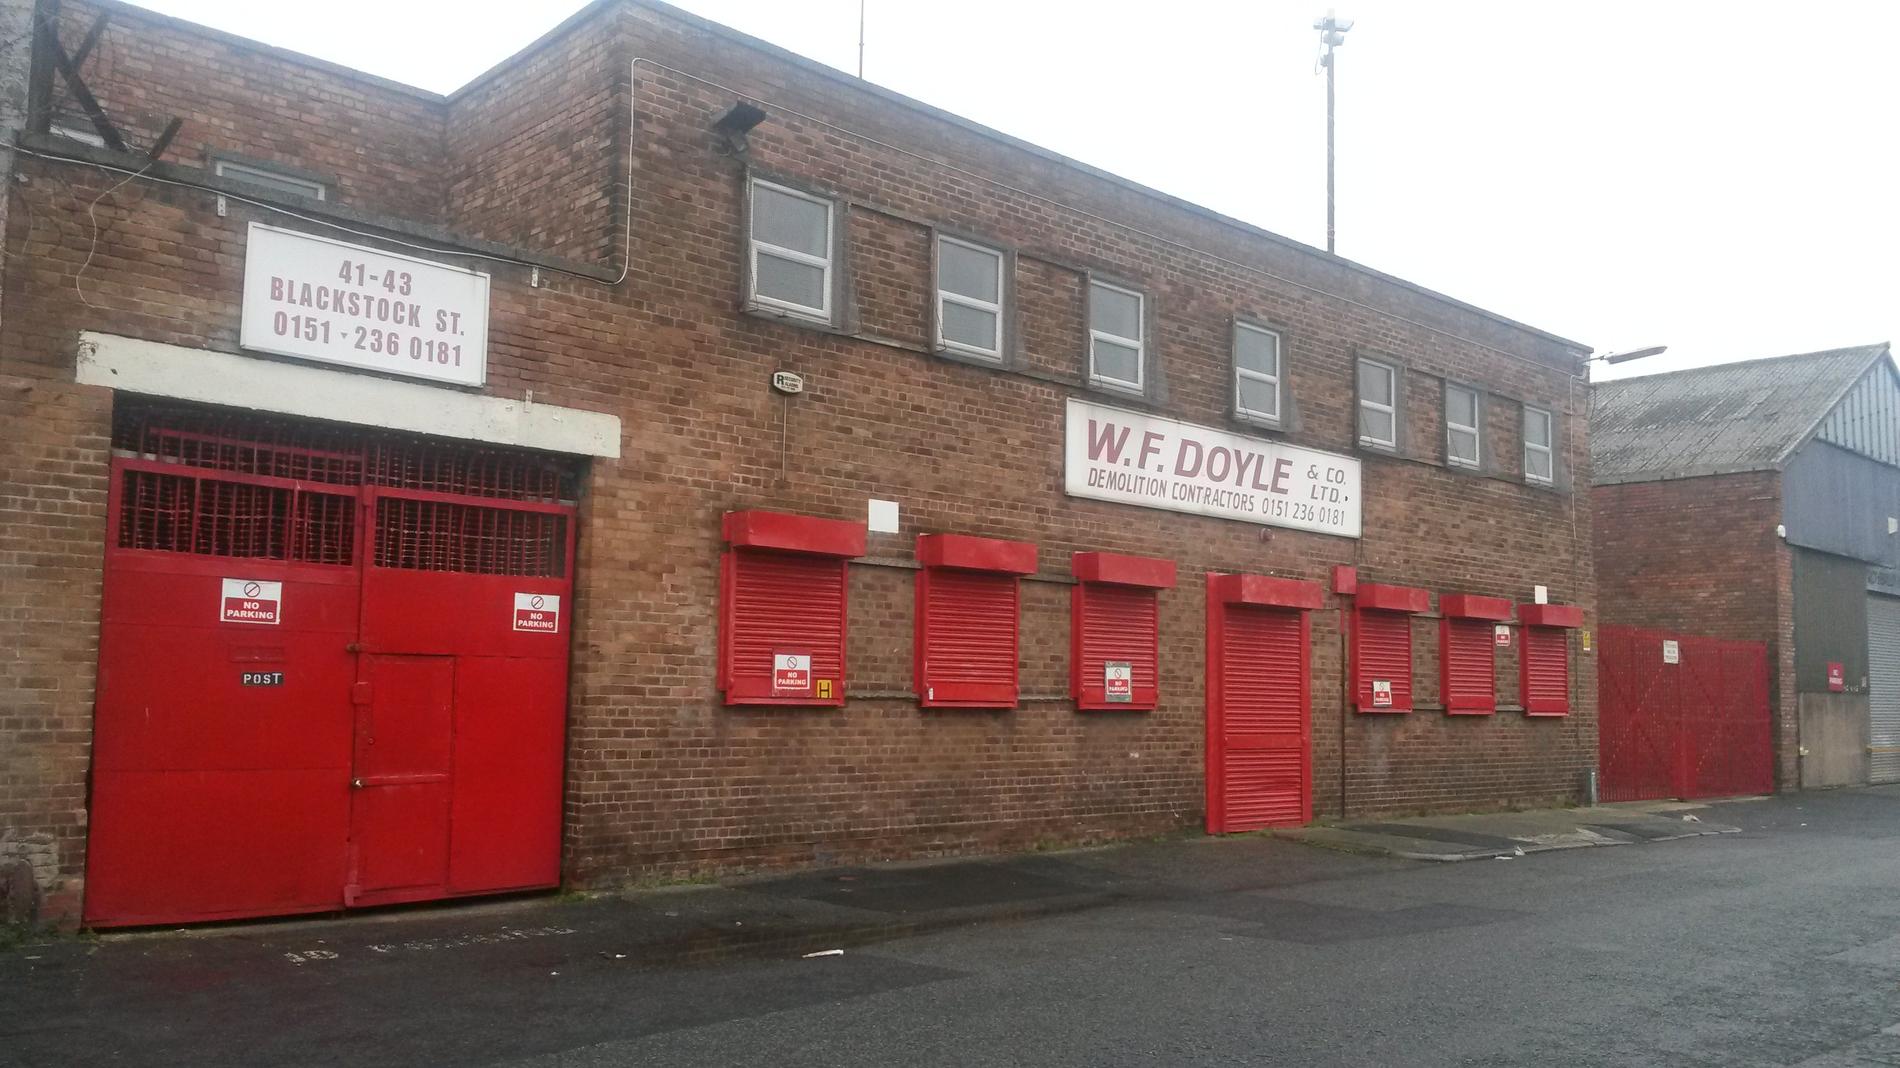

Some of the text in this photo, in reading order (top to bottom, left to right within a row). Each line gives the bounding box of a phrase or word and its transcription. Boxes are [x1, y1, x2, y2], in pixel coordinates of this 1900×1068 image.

[338, 260, 412, 296] 41-43
[270, 276, 465, 337] BLACKSTOCK ST.
[274, 311, 461, 367] 0151 236 0181
[1173, 438, 1294, 495] DOYLE
[1306, 464, 1319, 480] &
[1326, 467, 1347, 485] CO.
[1087, 467, 1345, 526] DEMOLITION CONTRACTORS 0151 236 0181
[1310, 484, 1341, 504] LTD.
[226, 609, 274, 620] PARKING
[243, 601, 260, 610] NO
[518, 620, 554, 629] PARKING
[530, 612, 543, 620] NO
[243, 672, 282, 685] POST
[787, 671, 798, 679] NO
[819, 681, 830, 699] H
